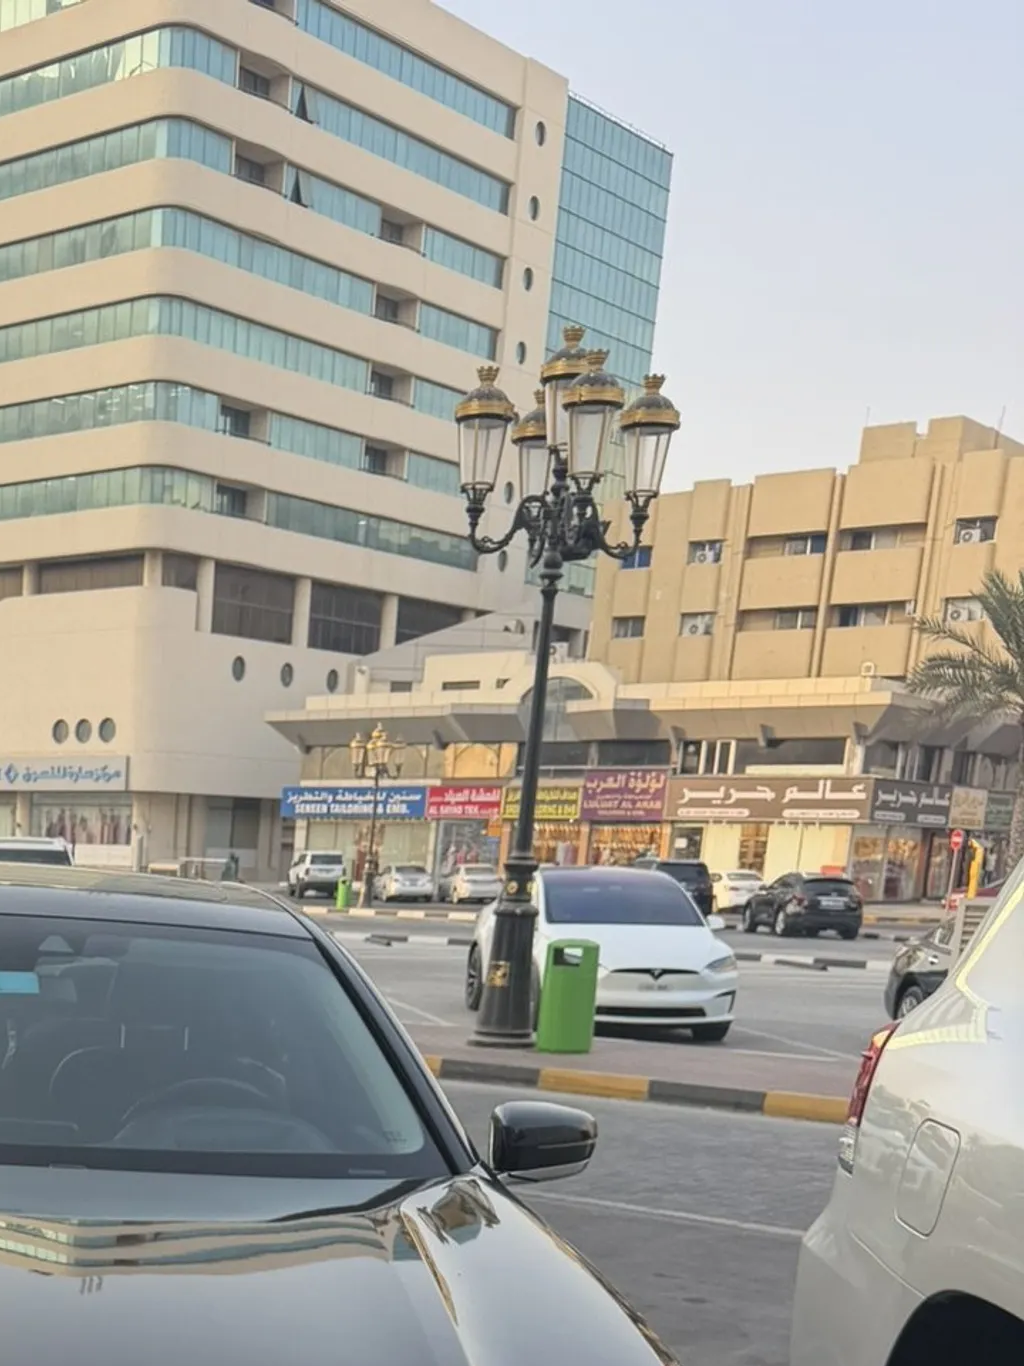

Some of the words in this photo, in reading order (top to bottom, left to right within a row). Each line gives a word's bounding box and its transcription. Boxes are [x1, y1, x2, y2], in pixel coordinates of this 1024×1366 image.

[586, 773, 628, 794] العرب
[781, 779, 867, 803] عالم
[677, 785, 776, 805] حرير
[875, 788, 917, 808] حرير
